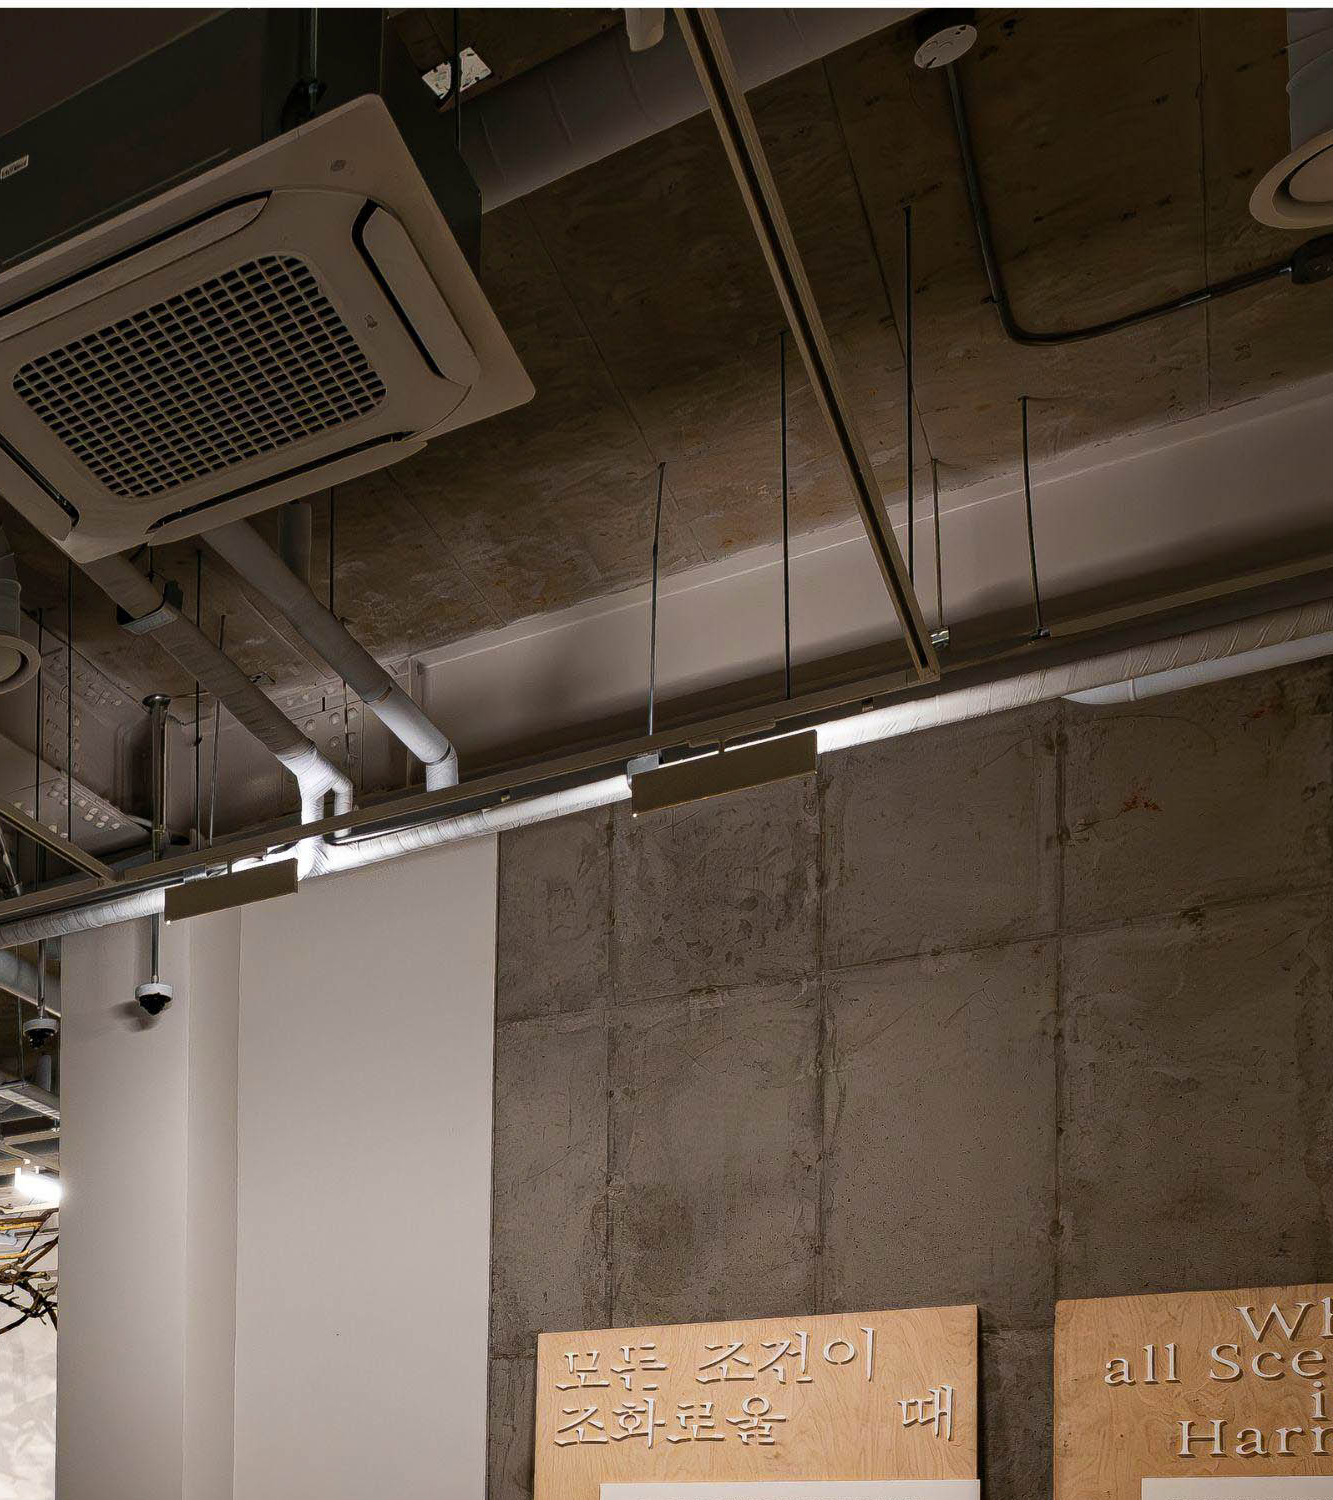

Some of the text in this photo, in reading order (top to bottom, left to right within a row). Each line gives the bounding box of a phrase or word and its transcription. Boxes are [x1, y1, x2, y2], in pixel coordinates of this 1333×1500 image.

[555, 1327, 875, 1391] 모든 조건이
[1104, 1343, 1327, 1385] all Sce
[554, 1384, 955, 1449] 조화로울 때
